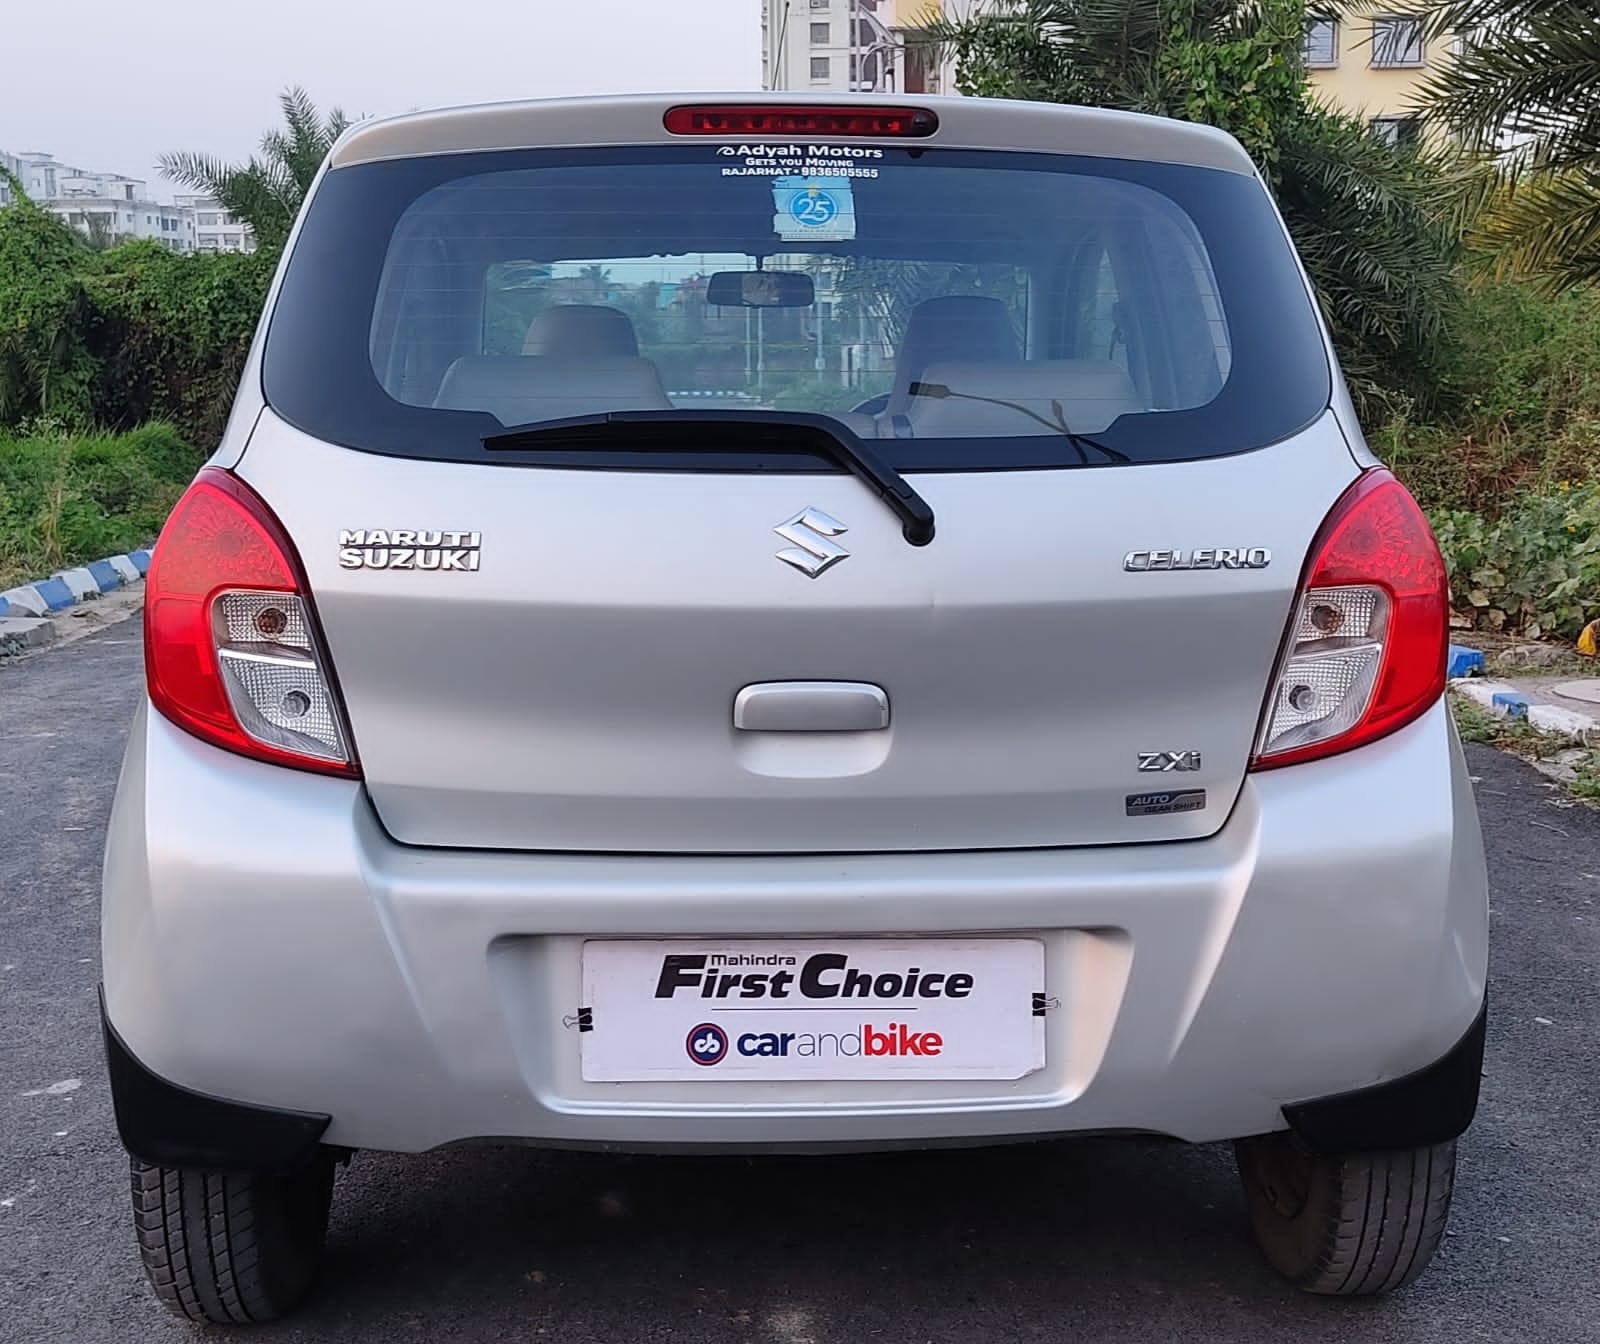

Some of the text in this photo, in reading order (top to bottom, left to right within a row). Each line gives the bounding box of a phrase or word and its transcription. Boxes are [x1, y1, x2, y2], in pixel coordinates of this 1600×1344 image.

[736, 144, 883, 158] Adyah Motors
[721, 167, 879, 178] RAJARHAT 9836505555
[798, 198, 831, 222] 25
[339, 529, 481, 547] MARUTI
[339, 547, 481, 571] SUZUKI
[1123, 548, 1272, 571] CELERIO
[1131, 794, 1170, 806] AUTO
[711, 954, 796, 966] Mahindra
[654, 953, 974, 998] First Choice
[736, 1023, 943, 1057] carandbike
